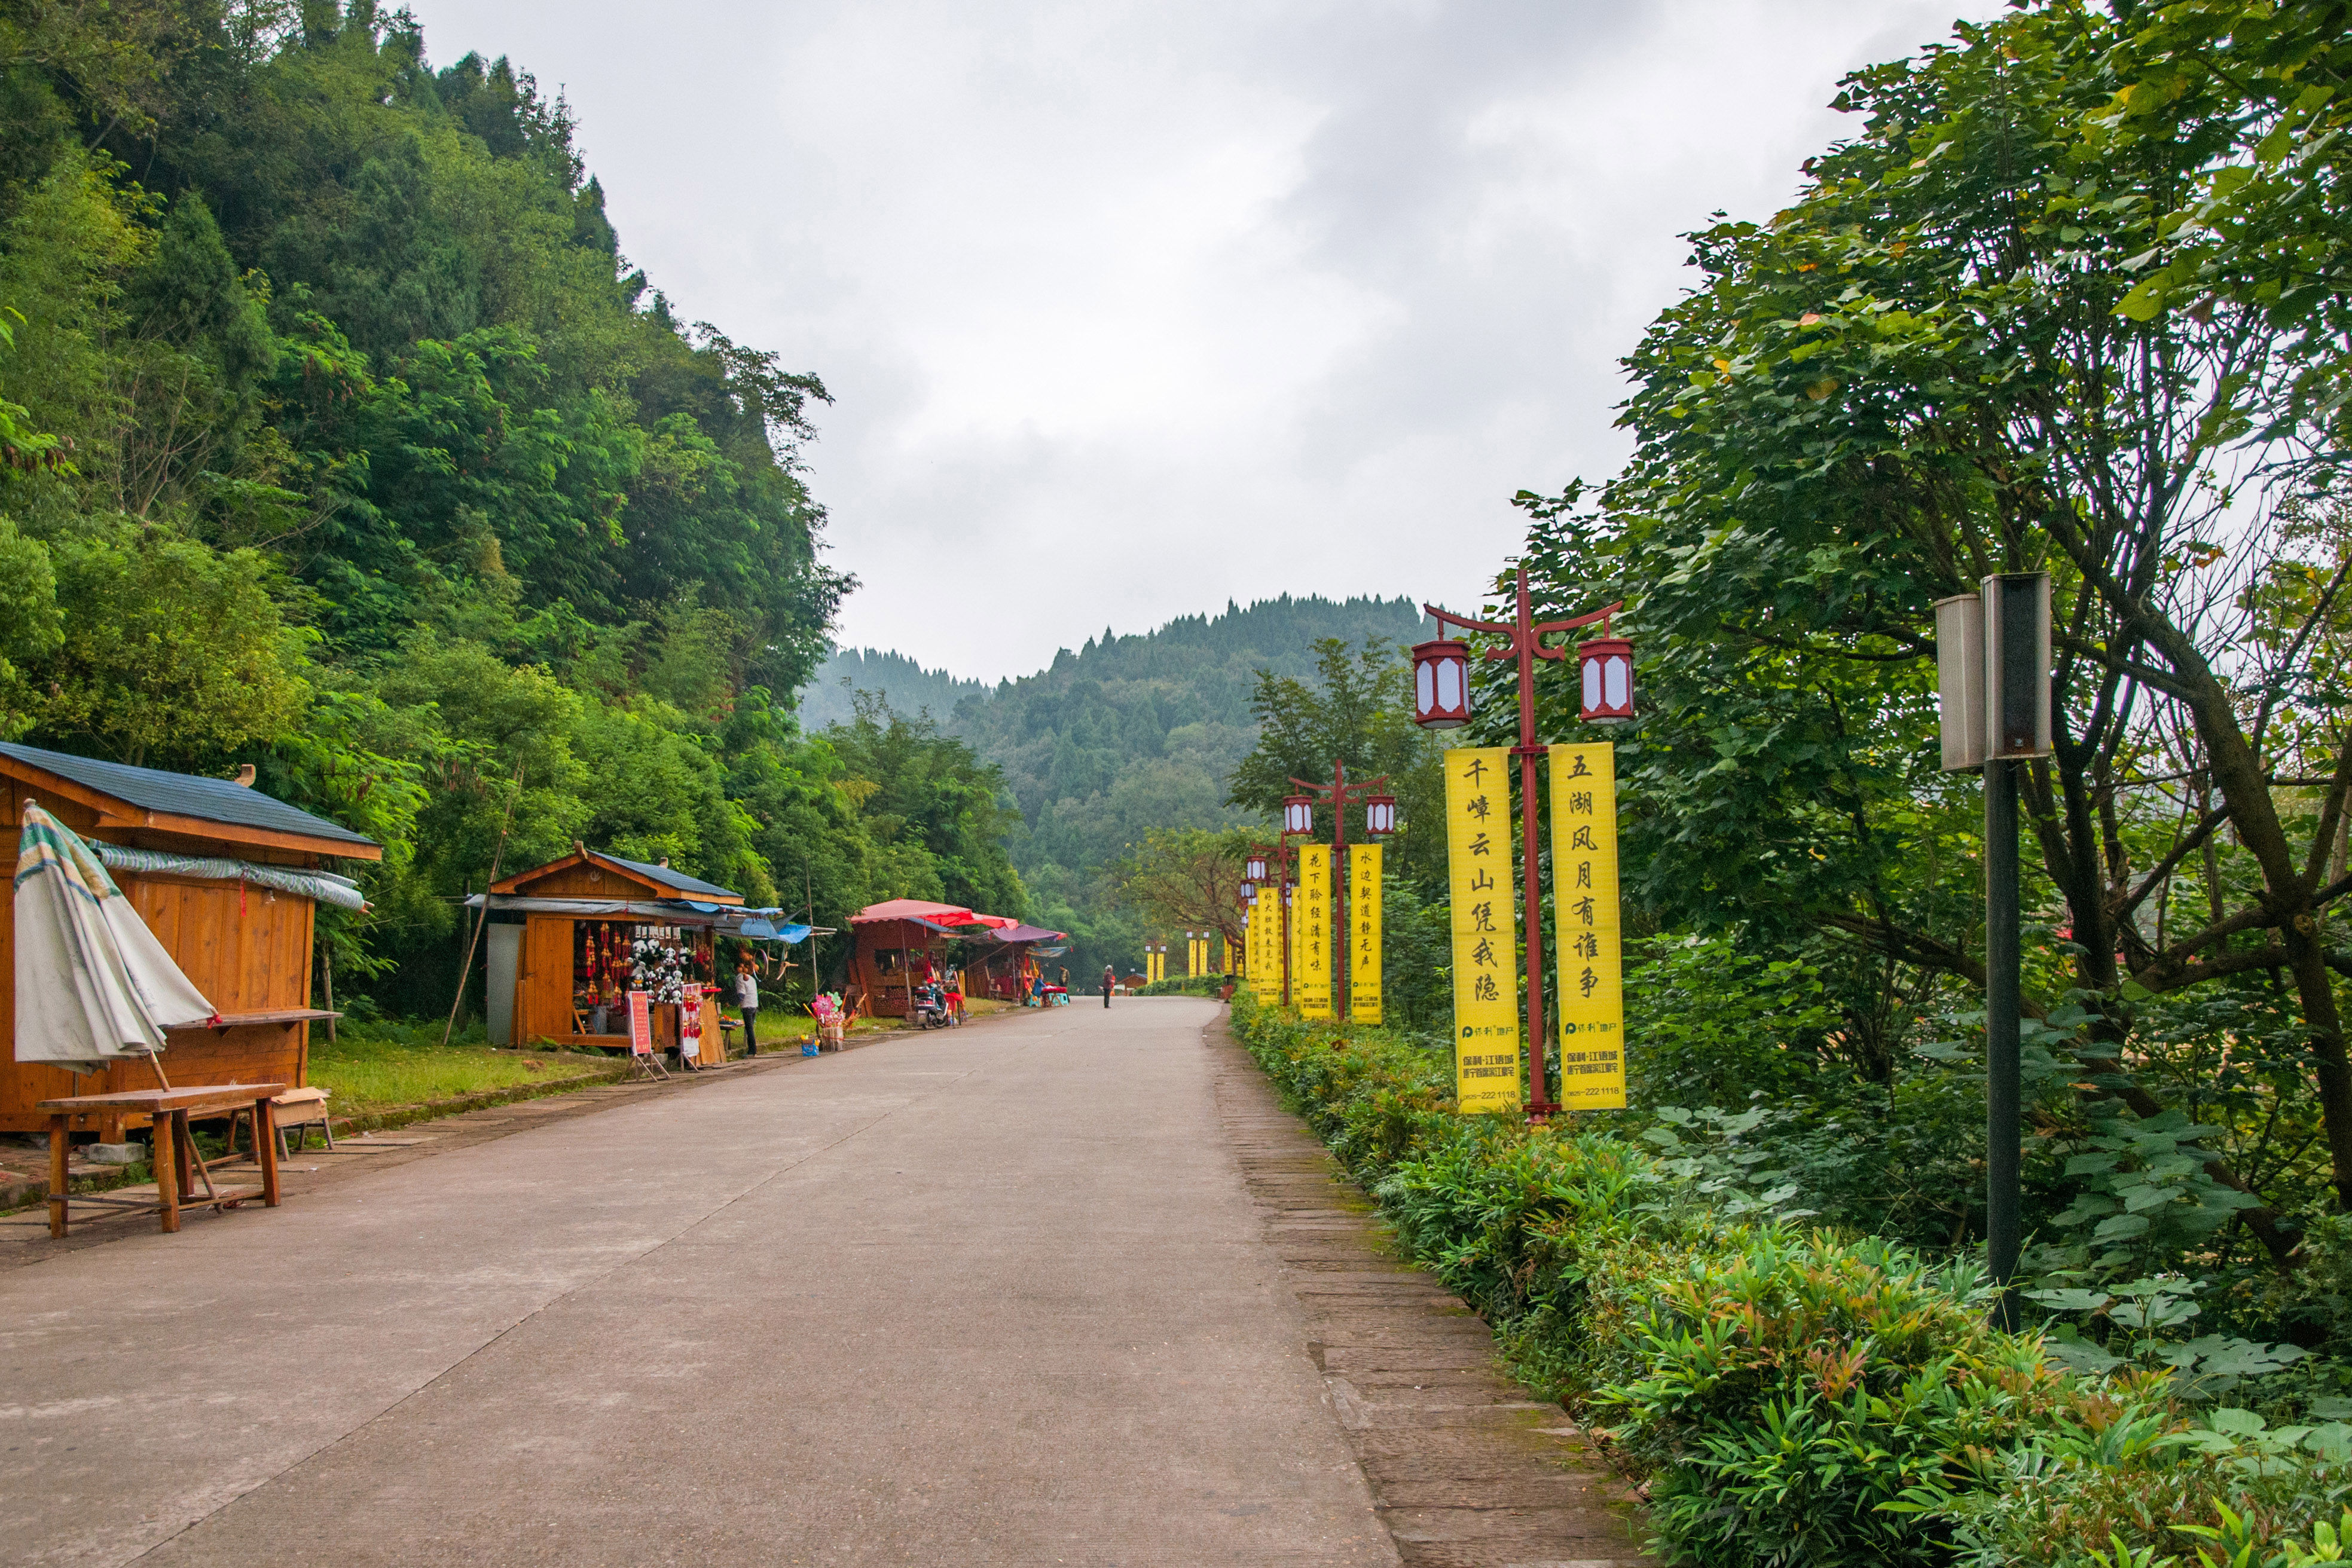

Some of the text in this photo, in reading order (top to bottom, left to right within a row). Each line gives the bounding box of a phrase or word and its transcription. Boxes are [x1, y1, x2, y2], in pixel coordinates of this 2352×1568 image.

[1309, 852, 1322, 971] 花下聆经清有味
[1464, 759, 1499, 1002] 千嶂云山凭我隐
[1567, 755, 1599, 998] 五湖风月有谁争
